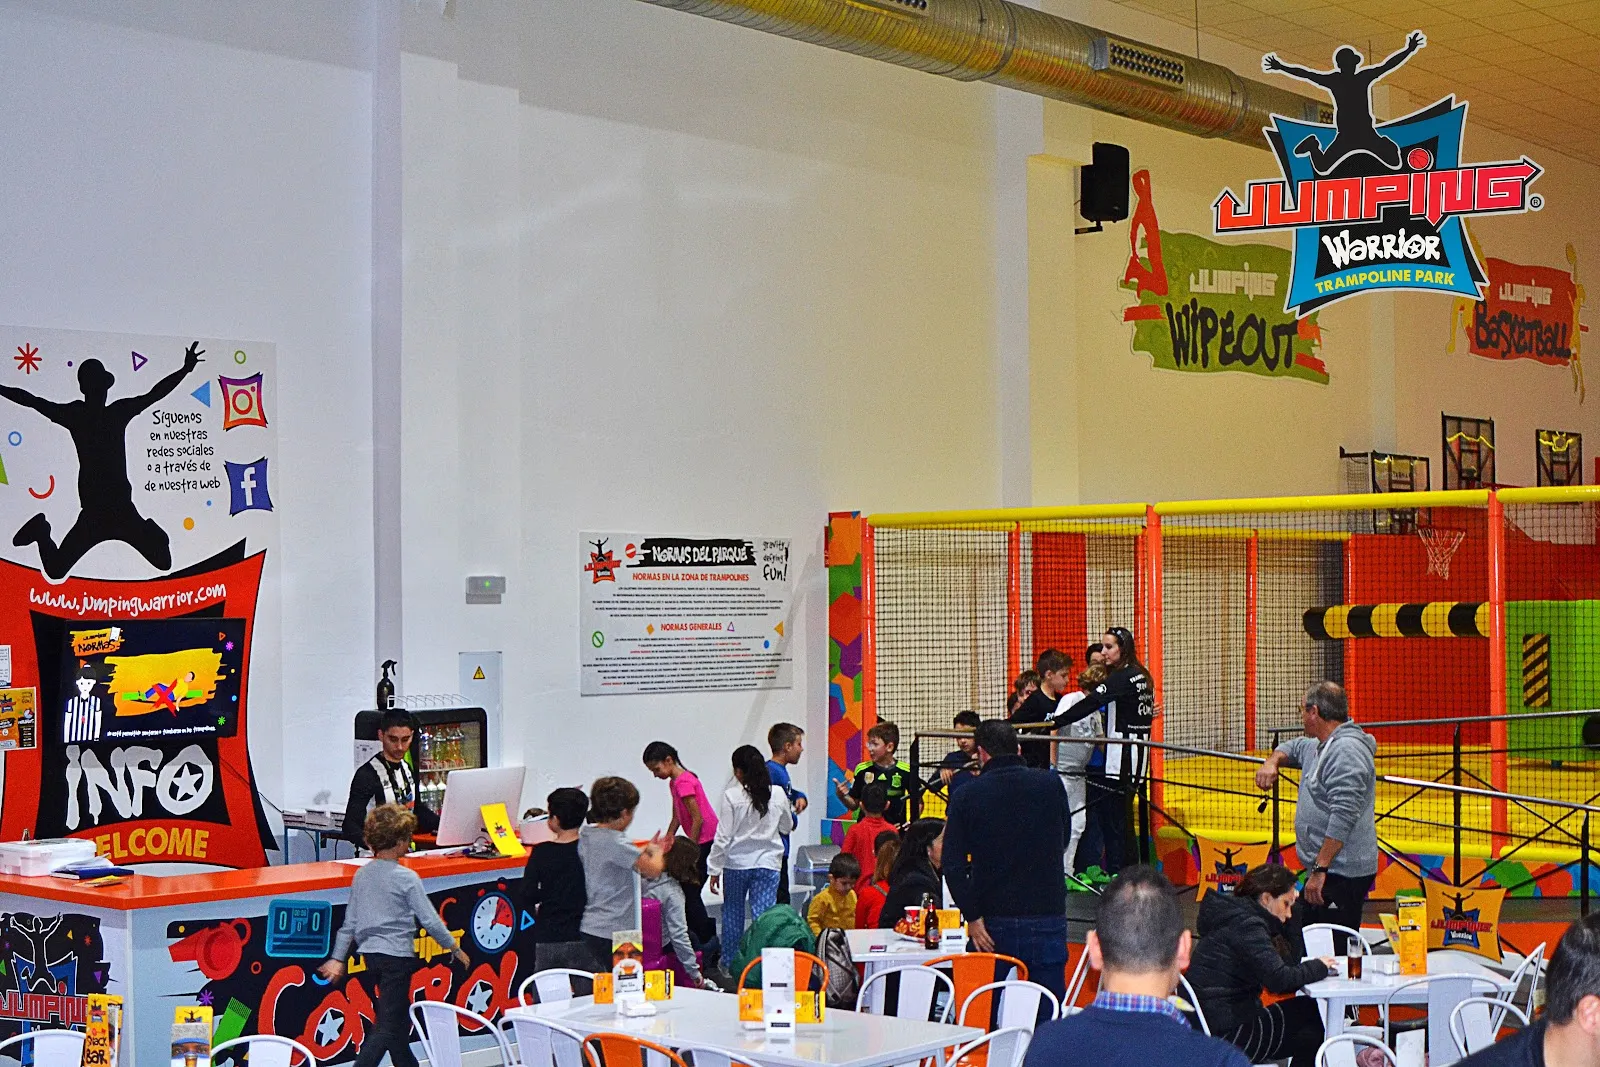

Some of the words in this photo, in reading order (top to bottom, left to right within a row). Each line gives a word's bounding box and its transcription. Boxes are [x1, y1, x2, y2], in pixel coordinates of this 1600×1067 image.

[152, 410, 202, 428] Síguenos
[150, 432, 161, 441] en
[164, 429, 208, 443] nuestras
[147, 446, 175, 457] redes
[177, 444, 214, 456] sociales
[155, 464, 161, 473] a
[163, 460, 198, 476] través
[200, 460, 211, 471] de
[144, 480, 157, 491] de
[159, 479, 198, 493] nuestra
[200, 476, 221, 489] web
[692, 545, 712, 562] DEL
[712, 546, 748, 563] PARQUE
[632, 573, 661, 581] NORMAS
[662, 573, 670, 581] EN
[671, 573, 680, 581] LA
[681, 573, 699, 581] ZONA
[700, 573, 709, 581] DE
[709, 573, 750, 582] TRAMPOLINES
[30, 583, 226, 617] www.jumpingwarrior.com
[661, 623, 689, 631] NORMAS
[689, 622, 722, 631] GENERALES
[96, 826, 210, 860] ELCOME
